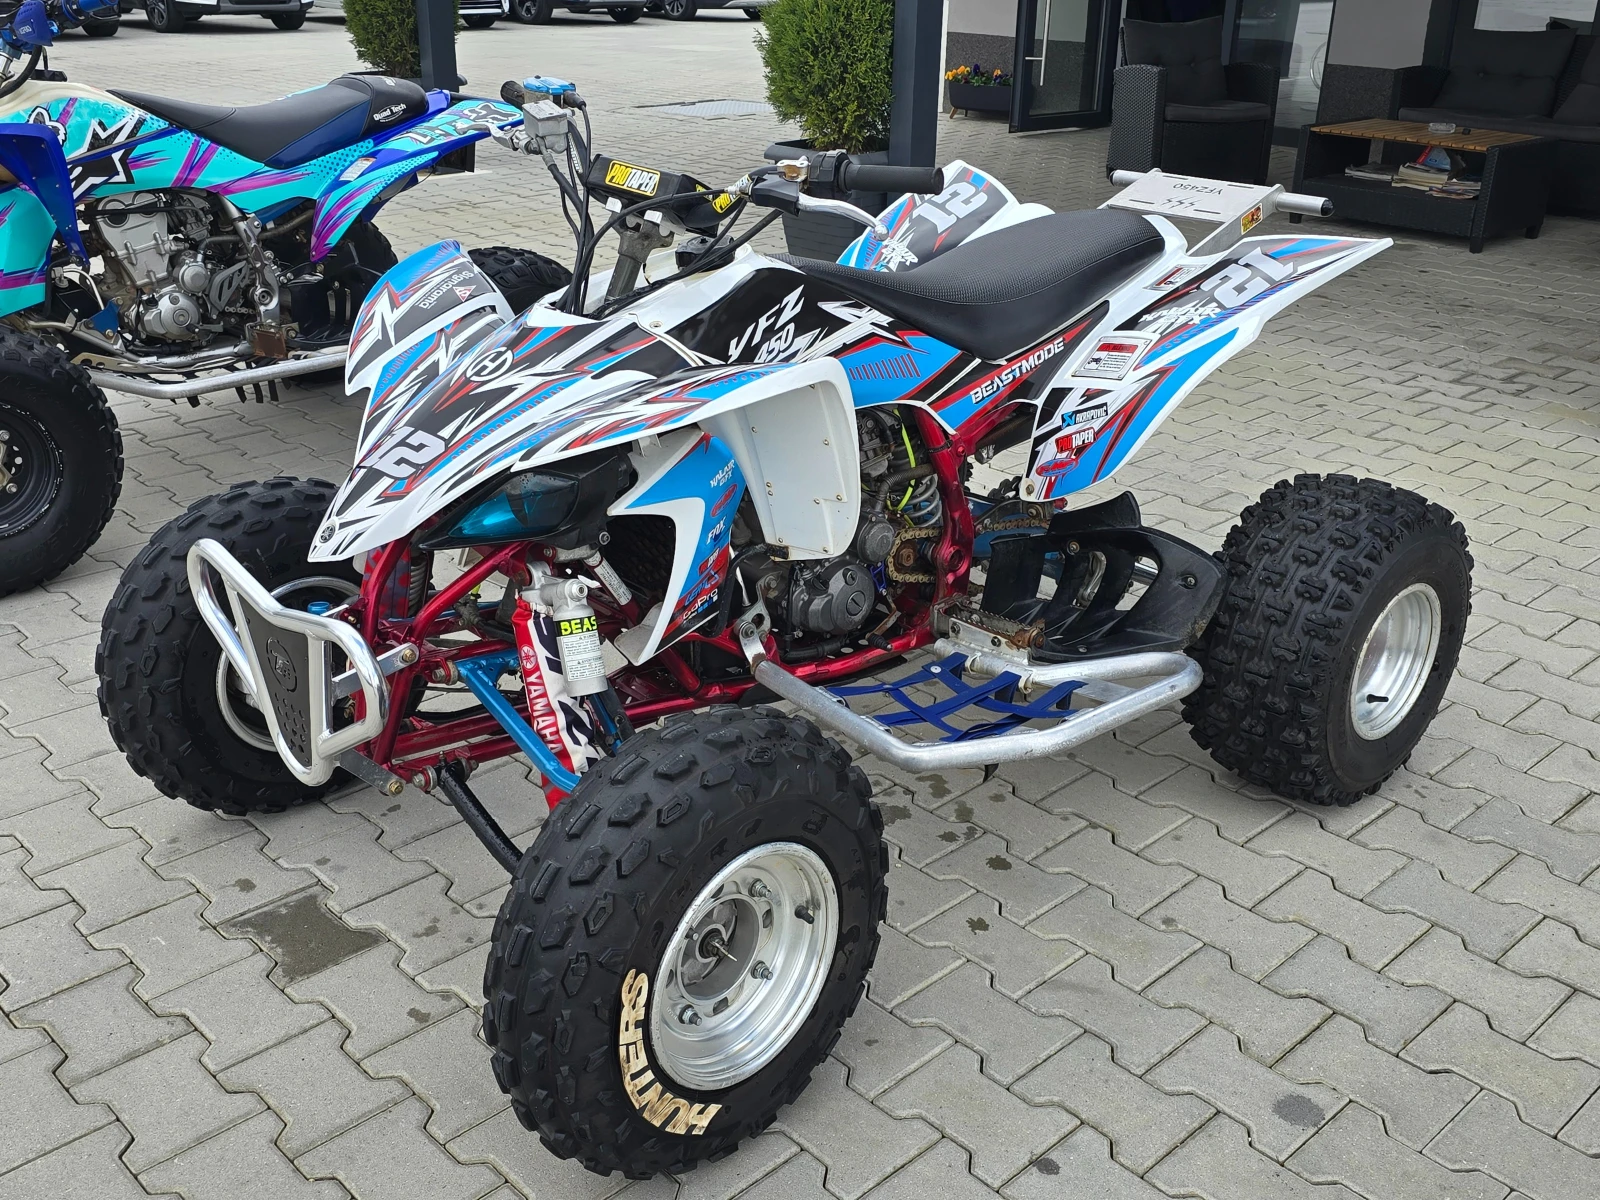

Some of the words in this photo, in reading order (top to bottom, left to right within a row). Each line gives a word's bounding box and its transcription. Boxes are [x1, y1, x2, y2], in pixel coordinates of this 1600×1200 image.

[373, 108, 391, 121] Quad
[392, 103, 407, 114] Tech
[607, 162, 657, 193] PROTAPER
[1173, 183, 1223, 195] YFZ450
[912, 181, 988, 234] 12
[419, 270, 474, 309] Signarama
[727, 284, 805, 365] YFZ
[753, 322, 795, 363] 450
[970, 337, 1065, 405] BEASTMODE
[359, 426, 445, 478] 12
[1058, 428, 1094, 452] PROTAPER
[683, 588, 718, 619] GoPro
[526, 671, 563, 754] YAMAHA
[619, 968, 722, 1136] HUNTERS
